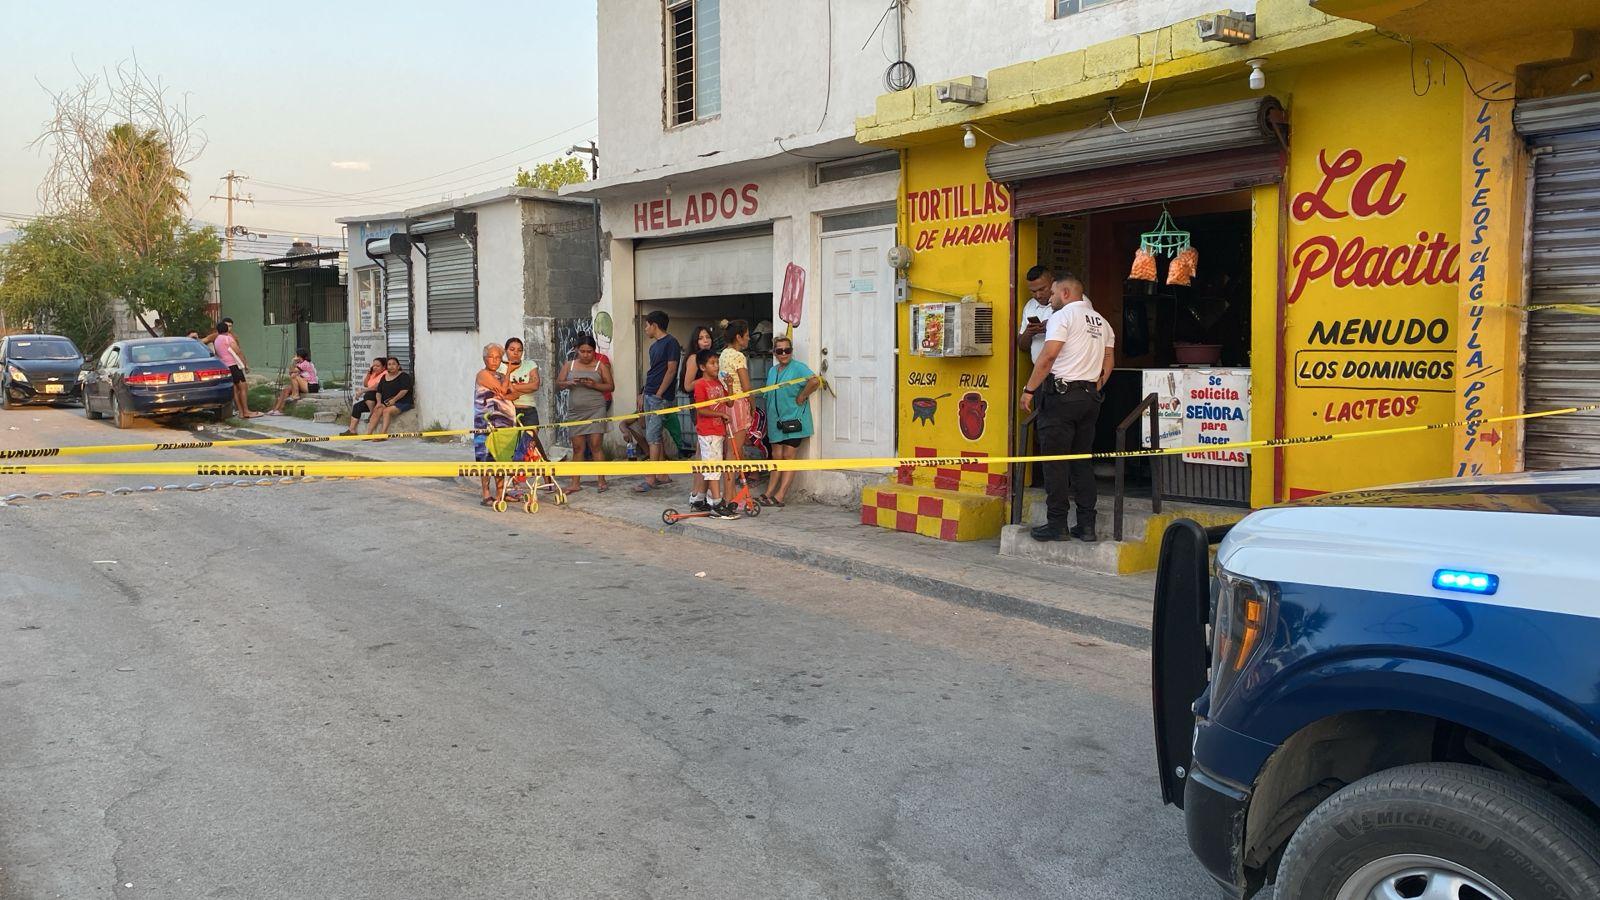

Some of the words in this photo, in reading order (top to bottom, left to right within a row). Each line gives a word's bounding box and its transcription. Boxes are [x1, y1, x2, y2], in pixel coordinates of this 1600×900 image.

[1291, 148, 1407, 221] La
[1471, 101, 1492, 245] LACTEOS
[634, 183, 759, 233] HELADOS
[908, 181, 1010, 224] TORTILLAS
[915, 229, 939, 252] DE
[941, 221, 1013, 248] HARINA
[1288, 231, 1460, 304] Placita
[1085, 315, 1102, 326] AIC
[1307, 318, 1449, 345] MENUDO
[908, 371, 937, 386] SALSA
[959, 373, 989, 388] FRIJOL
[1208, 375, 1222, 386] Se
[1299, 360, 1338, 379] LOS
[1342, 360, 1454, 380] DOMINGOS
[1190, 388, 1240, 400] solicita
[1186, 402, 1245, 421] SEÑORA
[1324, 395, 1419, 423] LACTEOS
[1201, 421, 1228, 432] para
[1198, 433, 1230, 445] hacer
[1377, 811, 1487, 843] MICHELIN
